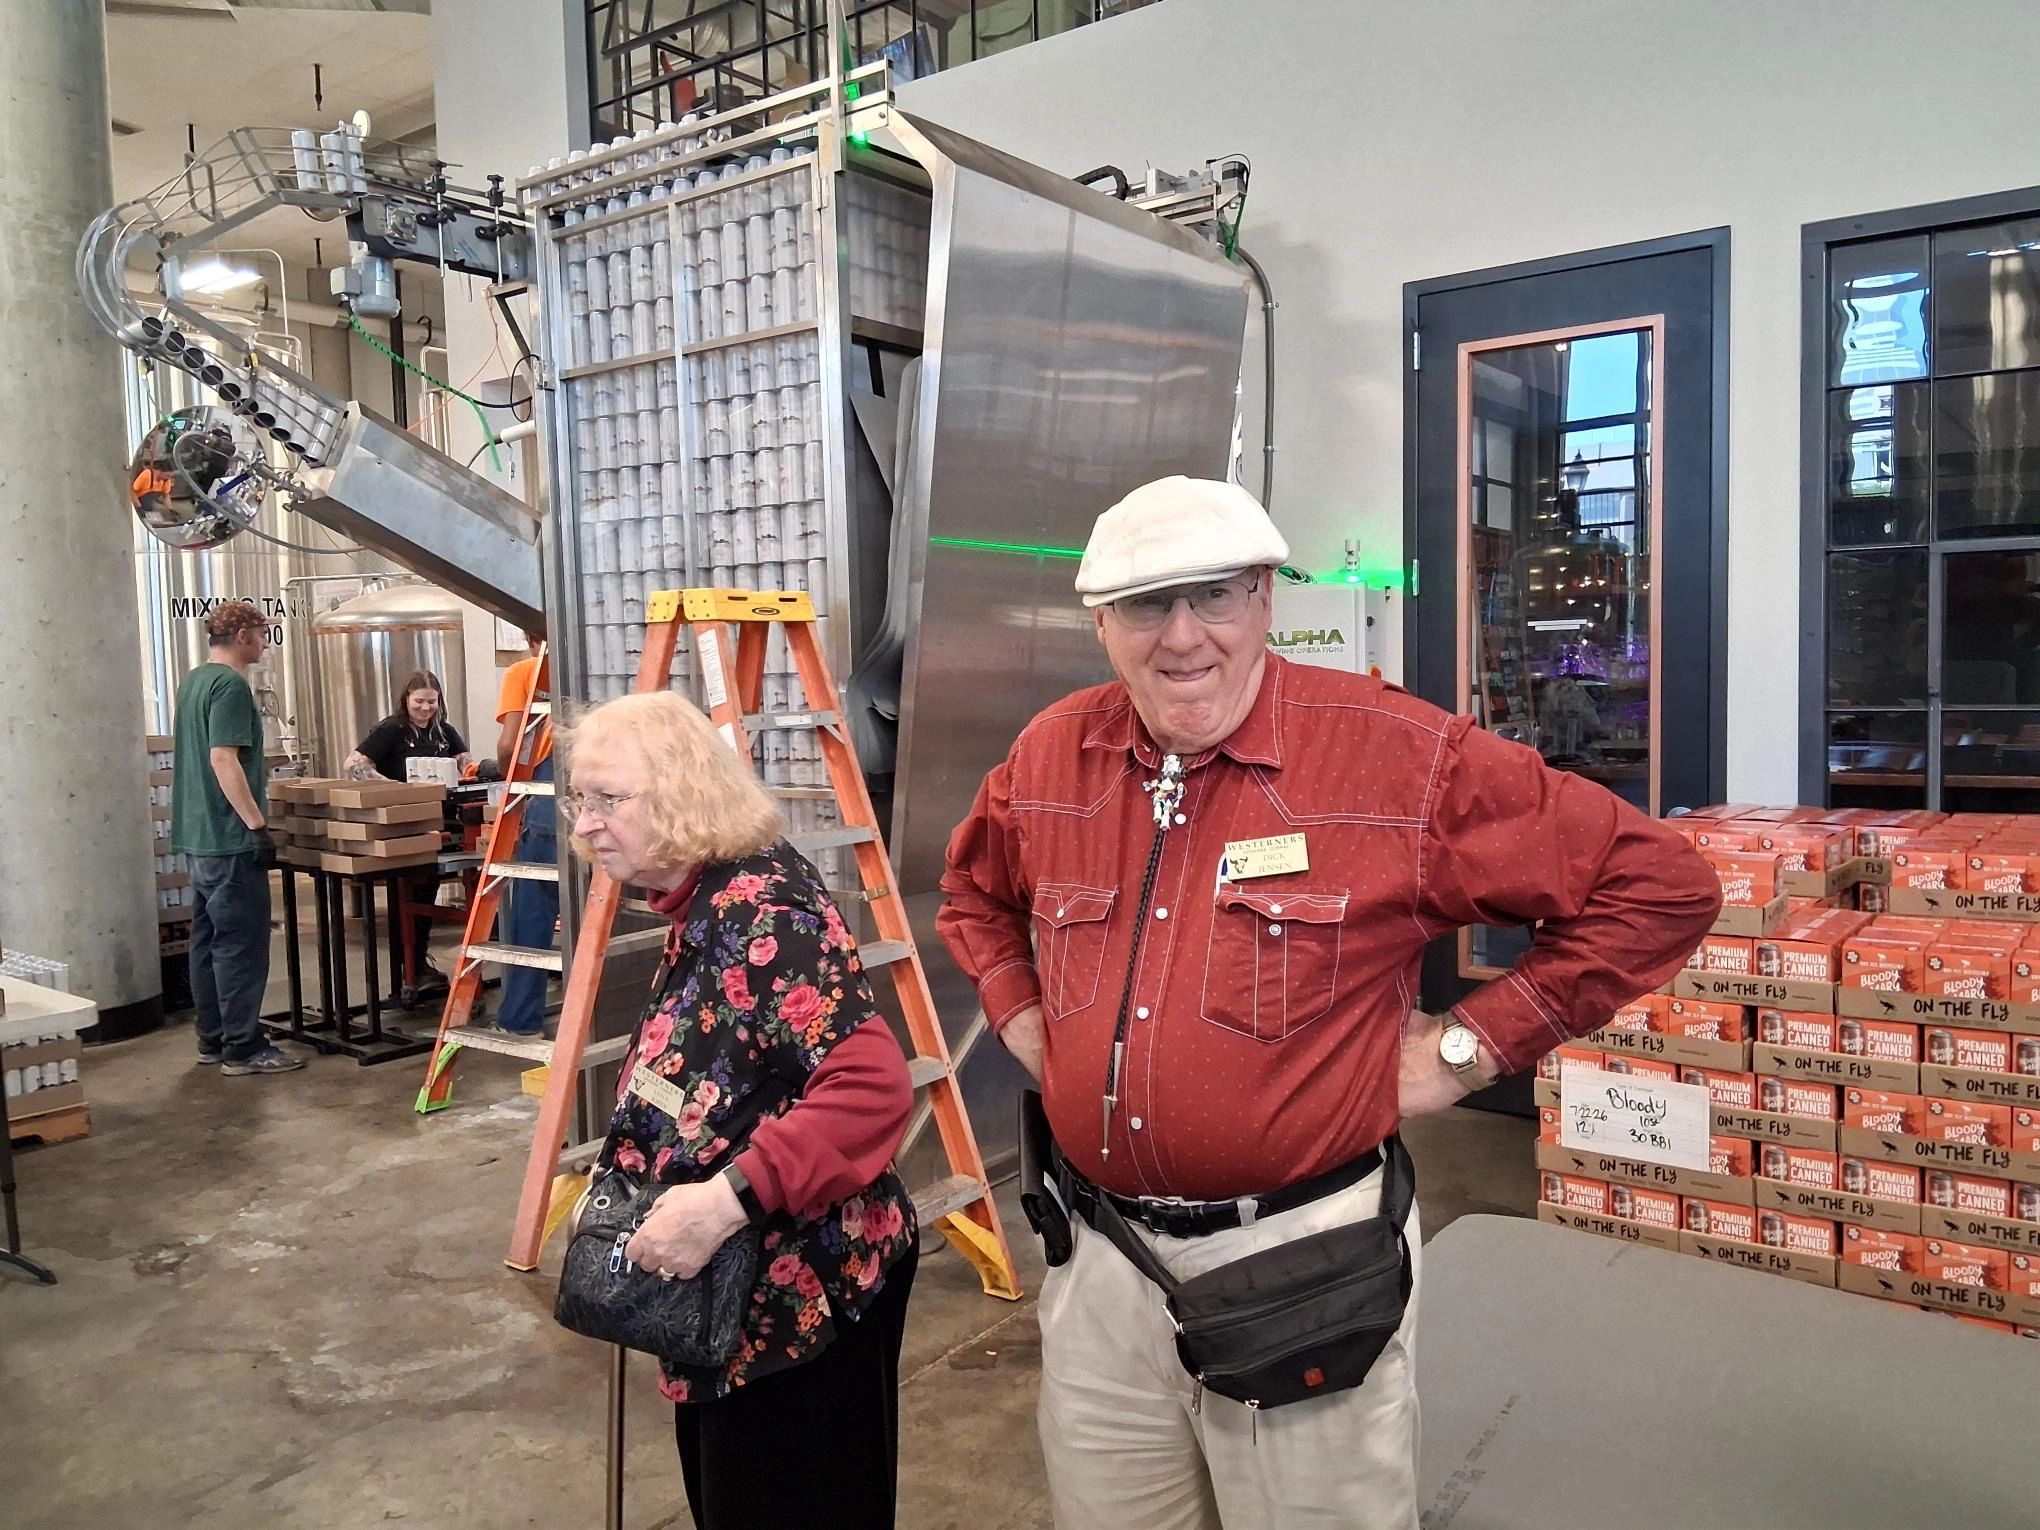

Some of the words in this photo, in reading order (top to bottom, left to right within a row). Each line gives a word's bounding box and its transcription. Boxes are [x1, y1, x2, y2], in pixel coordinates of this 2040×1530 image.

[1266, 629, 1345, 646] ALPHA
[1296, 646, 1344, 654] OPERATIONS
[1228, 836, 1304, 851] WESTERNERS
[1783, 854, 1806, 865] OODY
[1784, 862, 1807, 872] ARY
[1865, 862, 1883, 874] FLY
[1721, 878, 1752, 893] LOODY
[1909, 870, 1945, 887] BLOODY
[1984, 874, 2022, 891] BLOODY
[1724, 889, 1752, 902] MARY
[1956, 894, 1974, 908] ON
[1978, 896, 2008, 910] THE
[2017, 896, 2040, 912] FLY
[1707, 945, 1748, 957] PREMIUM
[1784, 952, 1827, 964] PREMIUM
[1707, 956, 1748, 970] CANNED
[1784, 962, 1826, 977] CANNED
[1861, 969, 1900, 987] BLOODY
[1944, 976, 1984, 994] BLOODY
[1713, 982, 1729, 993] ON
[1733, 983, 1759, 996] THE
[1766, 985, 1787, 1000] FLY
[1913, 999, 1934, 1013] ON
[1938, 1001, 1972, 1016] THE
[1982, 1003, 2009, 1022] FLY
[1614, 1011, 1648, 1027] BLOODY
[1684, 1021, 1720, 1036] BLOODY
[1787, 1021, 1831, 1035] PREMIUM
[1589, 1031, 1605, 1043] ON
[1608, 1033, 1635, 1047] THE
[1643, 1036, 1664, 1052] FLY
[1787, 1031, 1830, 1047] CANNED
[1867, 1030, 1912, 1044] PREMIUM
[1867, 1041, 1912, 1057] CANNED
[1958, 1039, 2005, 1054] PREMIUM
[1562, 1057, 1600, 1070] PREMIUM
[1958, 1050, 2005, 1067] CANNED
[1632, 1068, 1672, 1081] PREMIUM
[1795, 1058, 1811, 1069] ON
[1815, 1060, 1842, 1073] THE
[1850, 1063, 1872, 1078] FLY
[1710, 1078, 1750, 1092] PREMIUM
[1966, 1079, 1984, 1092] ON
[1988, 1082, 2019, 1095] THE
[2027, 1084, 2040, 1098] FL
[1710, 1089, 1750, 1105] CANNED
[1787, 1088, 1831, 1102] PREMIUM
[1606, 1088, 1667, 1119] Bloody
[1787, 1099, 1830, 1114] CANNED
[1717, 1115, 1733, 1126] ON
[1736, 1117, 1762, 1130] THE
[1769, 1121, 1790, 1136] FLY
[1862, 1111, 1901, 1128] BLOODY
[1629, 1128, 1647, 1143] 30
[1944, 1123, 1985, 1140] BLOODY
[1915, 1141, 1936, 1156] ON
[1940, 1145, 1973, 1162] THE
[1983, 1149, 2011, 1168] FLY
[1600, 1159, 1616, 1171] ON
[1619, 1162, 1647, 1177] THE
[1654, 1167, 1677, 1184] FLY
[1711, 1165, 1730, 1176] ARY
[1790, 1156, 1833, 1171] PREMIUM
[1790, 1167, 1833, 1184] CANNED
[1870, 1169, 1915, 1185] PREMIUM
[1566, 1183, 1603, 1197] PREMIUM
[1869, 1180, 1914, 1198] CANNED
[1958, 1182, 2006, 1199] PREMIUM
[1566, 1192, 1603, 1208] CANNED
[1635, 1196, 1674, 1211] PREMIUM
[1798, 1193, 1815, 1205] ON
[1818, 1196, 1845, 1210] THE
[1852, 1200, 1875, 1216] FLY
[1958, 1193, 2005, 1211] CANNED
[1635, 1206, 1674, 1223] CANNED
[1711, 1211, 1751, 1226] PREMIUM
[1574, 1216, 1588, 1228] ON
[1591, 1220, 1615, 1233] THE
[1620, 1224, 1640, 1240] FLY
[1711, 1221, 1751, 1237] CANNED
[1787, 1223, 1830, 1239] PREMIUM
[1968, 1223, 1987, 1234] ON
[1991, 1226, 2020, 1240] THE
[2029, 1230, 2040, 1246] FL
[1787, 1233, 1829, 1250] CANNED
[1718, 1247, 1734, 1259] ON
[1737, 1250, 1763, 1264] THE
[1769, 1254, 1790, 1271] FLY
[1861, 1250, 1899, 1265] BLOODY
[1943, 1265, 1983, 1280] BLOODY
[1911, 1281, 1931, 1295] ON
[1935, 1286, 1969, 1302] THE
[1978, 1292, 2006, 1312] FLY
